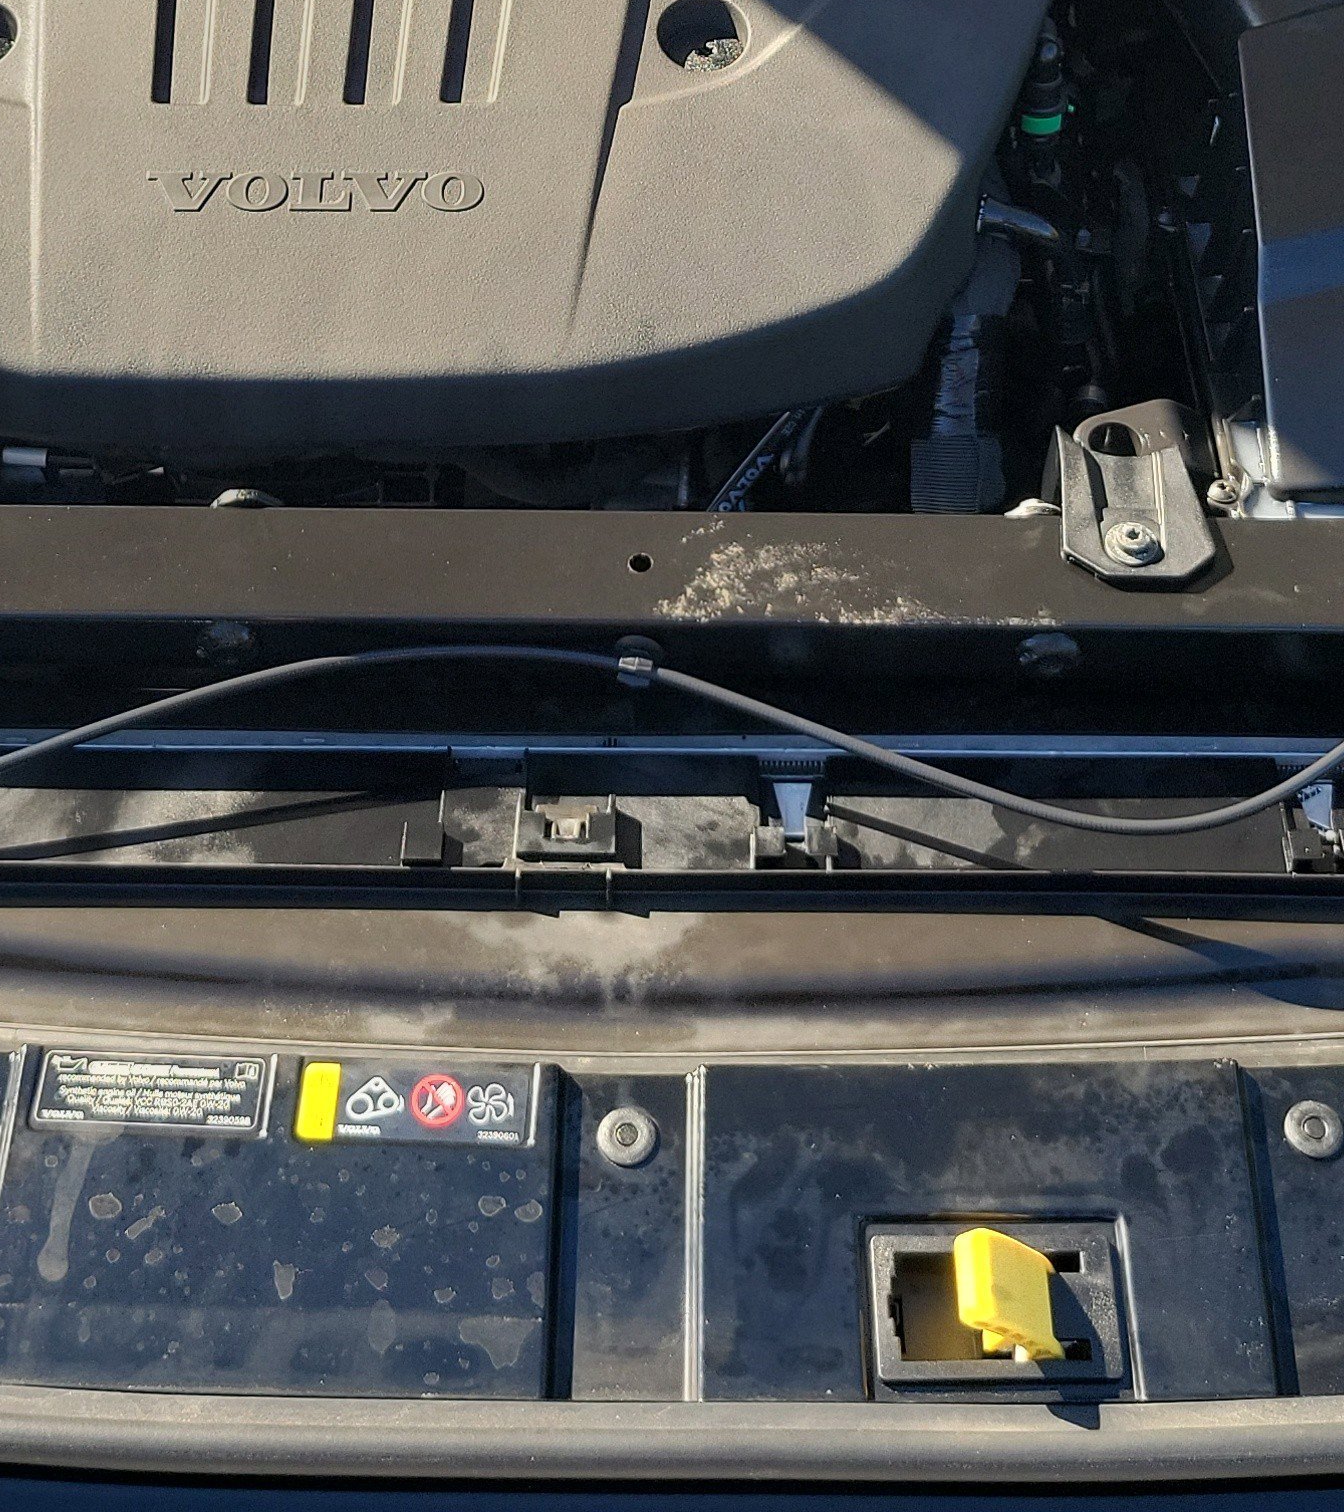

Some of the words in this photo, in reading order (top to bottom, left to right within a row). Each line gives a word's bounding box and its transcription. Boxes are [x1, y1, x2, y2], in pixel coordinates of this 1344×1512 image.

[146, 170, 485, 212] VOLVO
[718, 453, 774, 512] VOLVO
[41, 1109, 84, 1120] VOLVO
[338, 1124, 380, 1134] VOLVO
